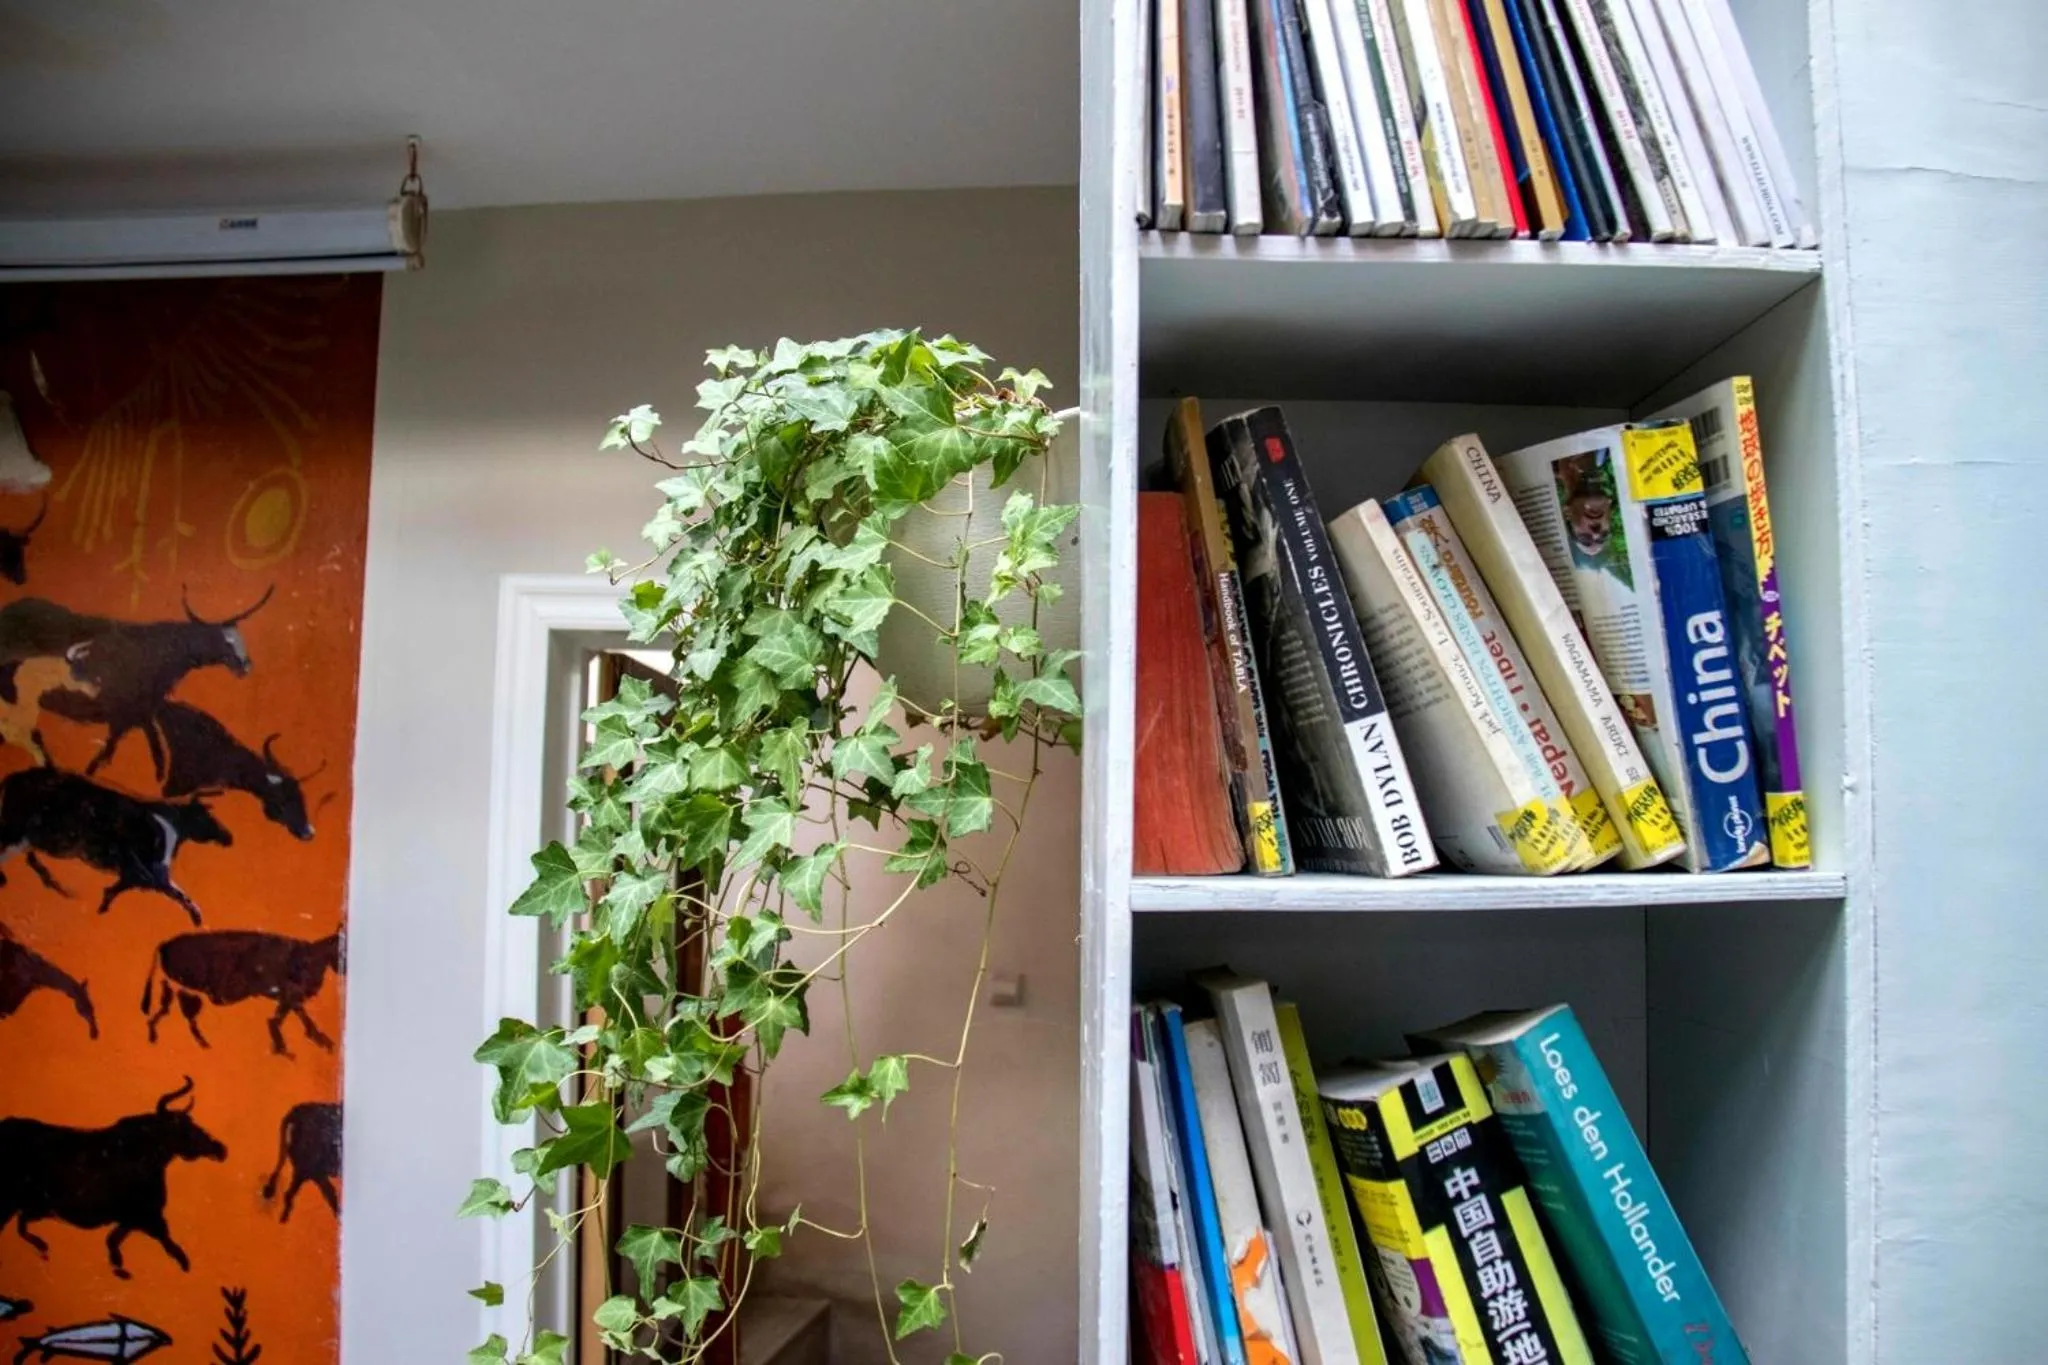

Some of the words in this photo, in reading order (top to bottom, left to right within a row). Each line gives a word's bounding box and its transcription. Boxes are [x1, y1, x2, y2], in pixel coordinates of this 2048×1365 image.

[1282, 478, 1299, 506] ONE
[1665, 522, 1698, 536] 100%
[1294, 507, 1319, 562] VOLUME
[1218, 572, 1237, 631] Handbook
[1307, 562, 1368, 710] CHRONICLES
[1466, 446, 1501, 505] CHINA
[1562, 633, 1602, 707] WAGAMAMA
[1600, 715, 1629, 757] ARUKI
[1228, 632, 1240, 647] of
[1232, 650, 1248, 694] TABLA
[1484, 630, 1524, 695] Tibet
[1764, 611, 1791, 718] チベット
[1478, 657, 1527, 746] ANSICHTEN
[1687, 610, 1750, 784] China
[1361, 722, 1407, 807] DYLAN
[1389, 811, 1423, 867] BOB
[1540, 1032, 1577, 1100] Loes
[1573, 1105, 1609, 1162] den
[1602, 1162, 1680, 1305] Hollander
[1445, 1167, 1548, 1365] 中国自助游(地
